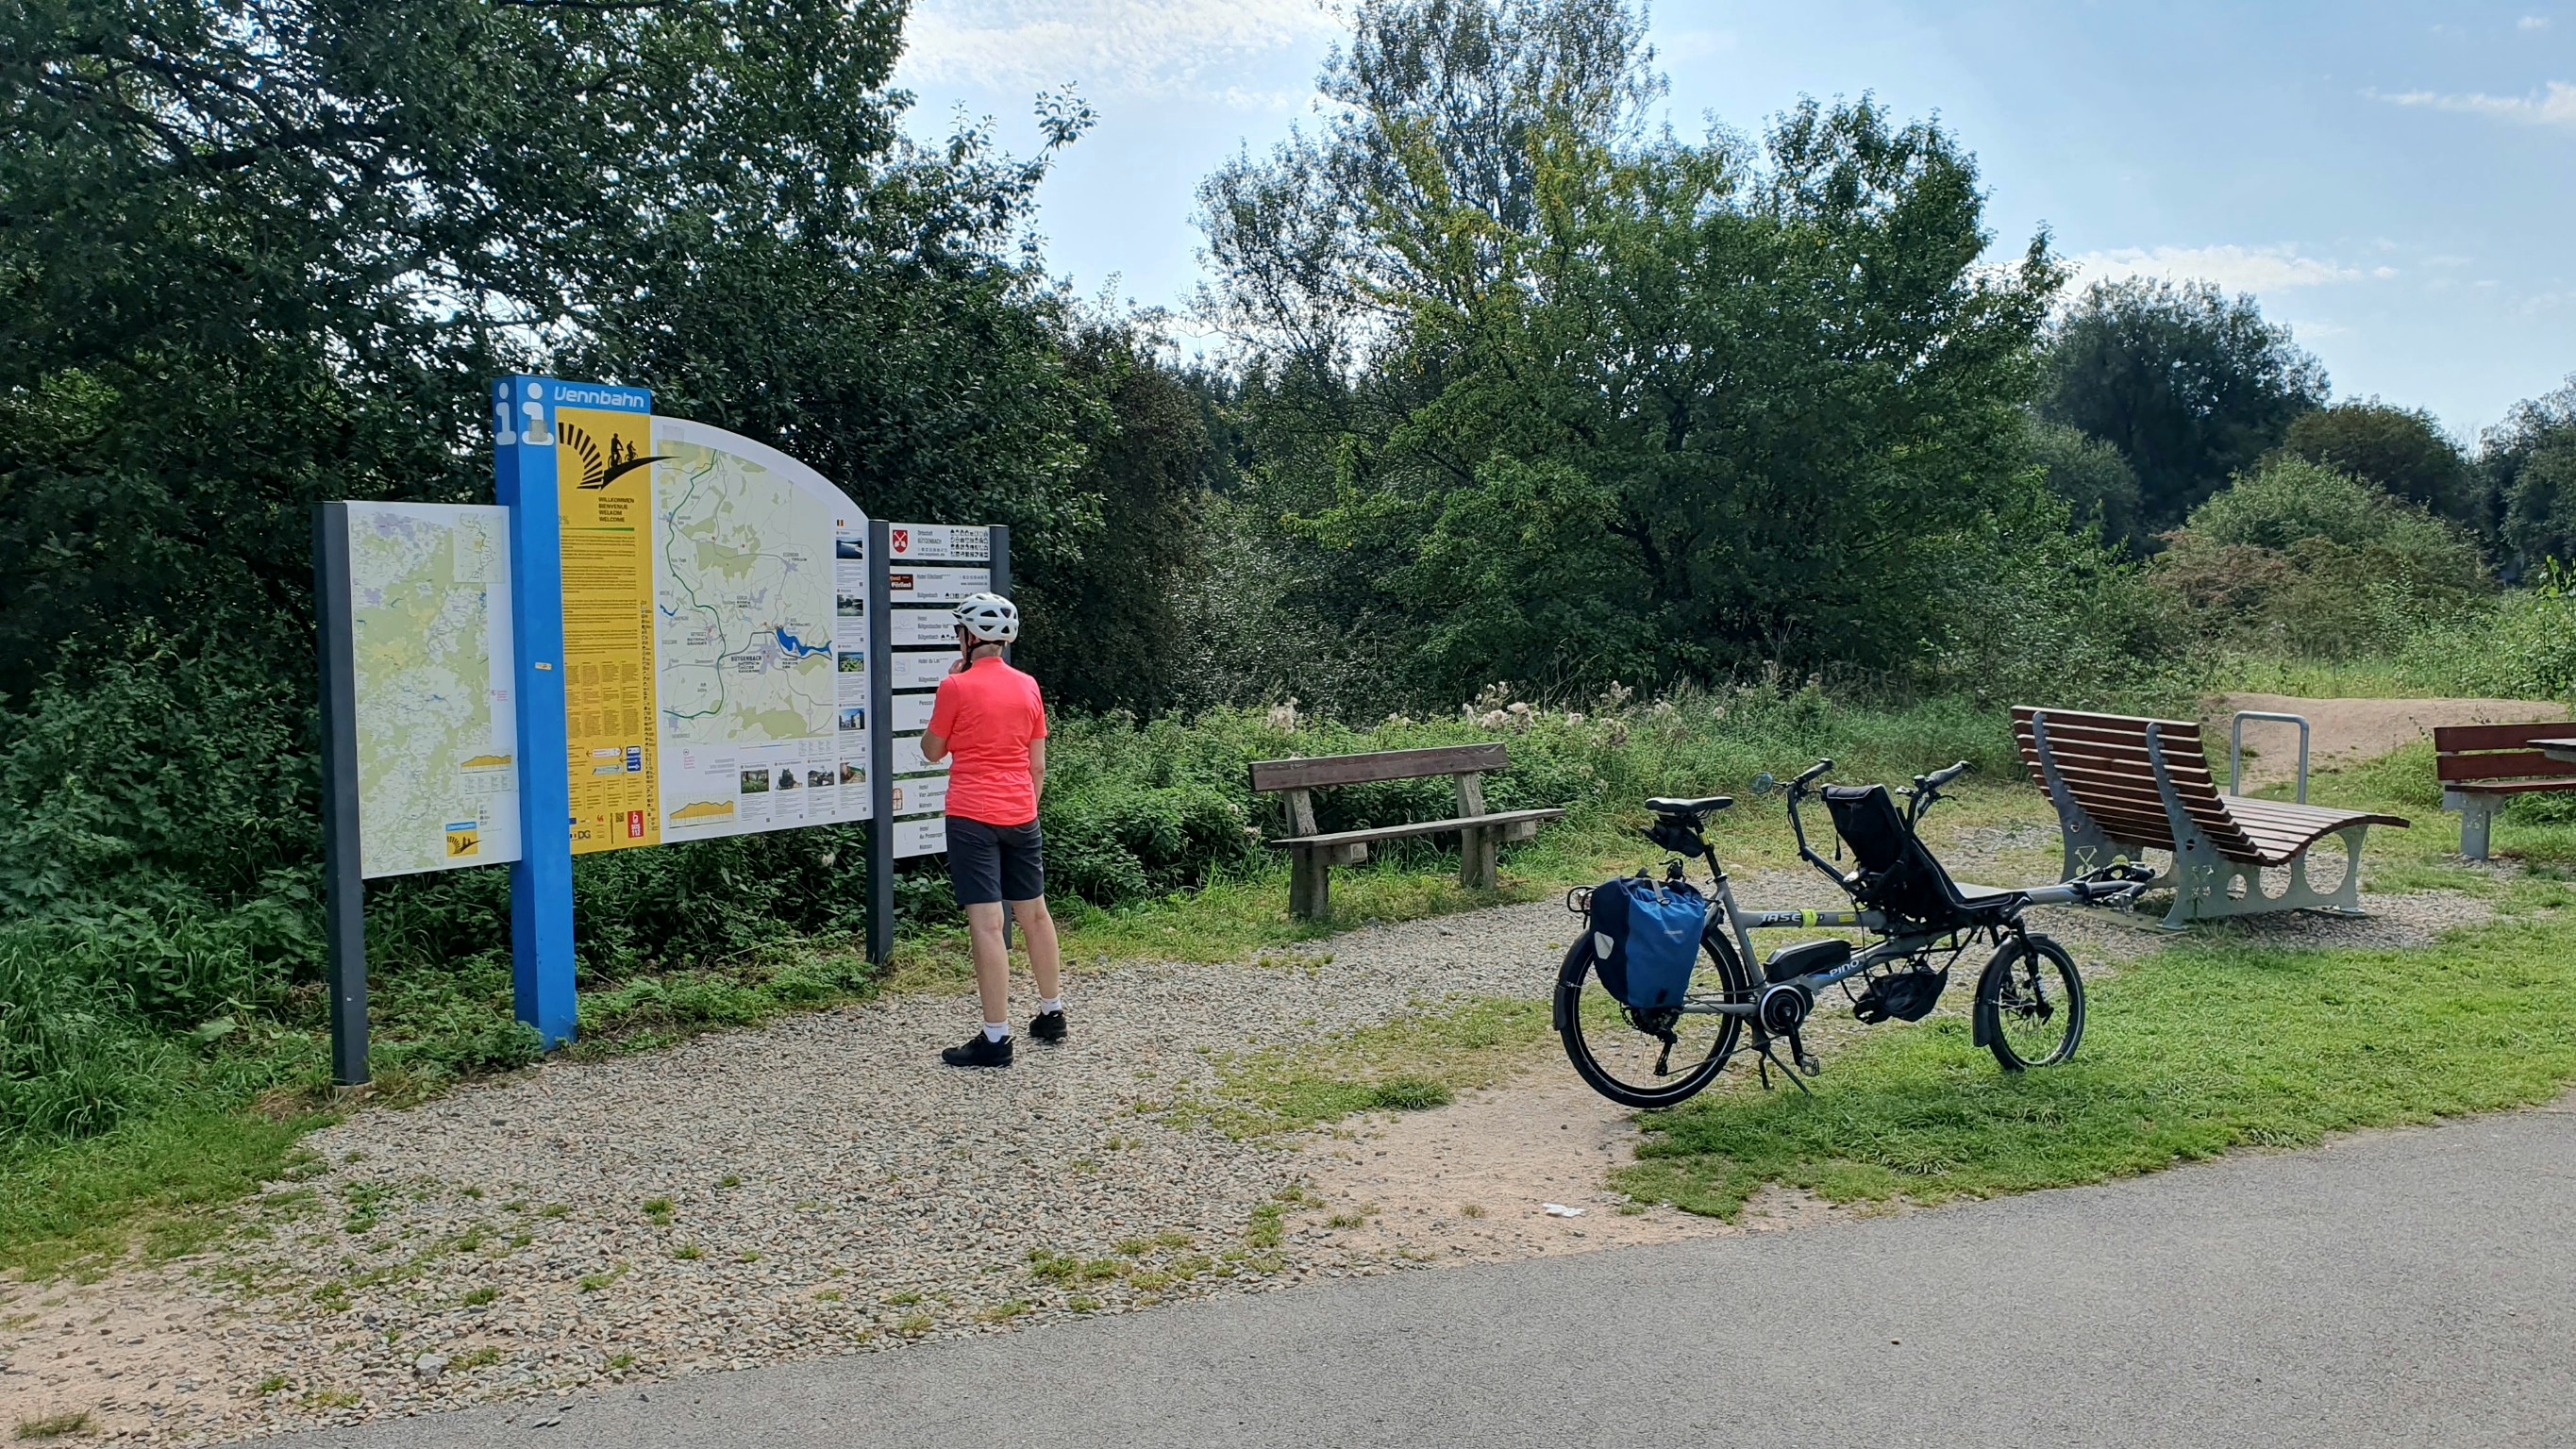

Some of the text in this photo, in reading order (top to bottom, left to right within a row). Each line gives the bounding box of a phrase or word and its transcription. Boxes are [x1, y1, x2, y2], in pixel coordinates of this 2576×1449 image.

[554, 385, 644, 408] Vennbahn
[577, 830, 592, 840] DG
[1829, 958, 1860, 977] PINO
